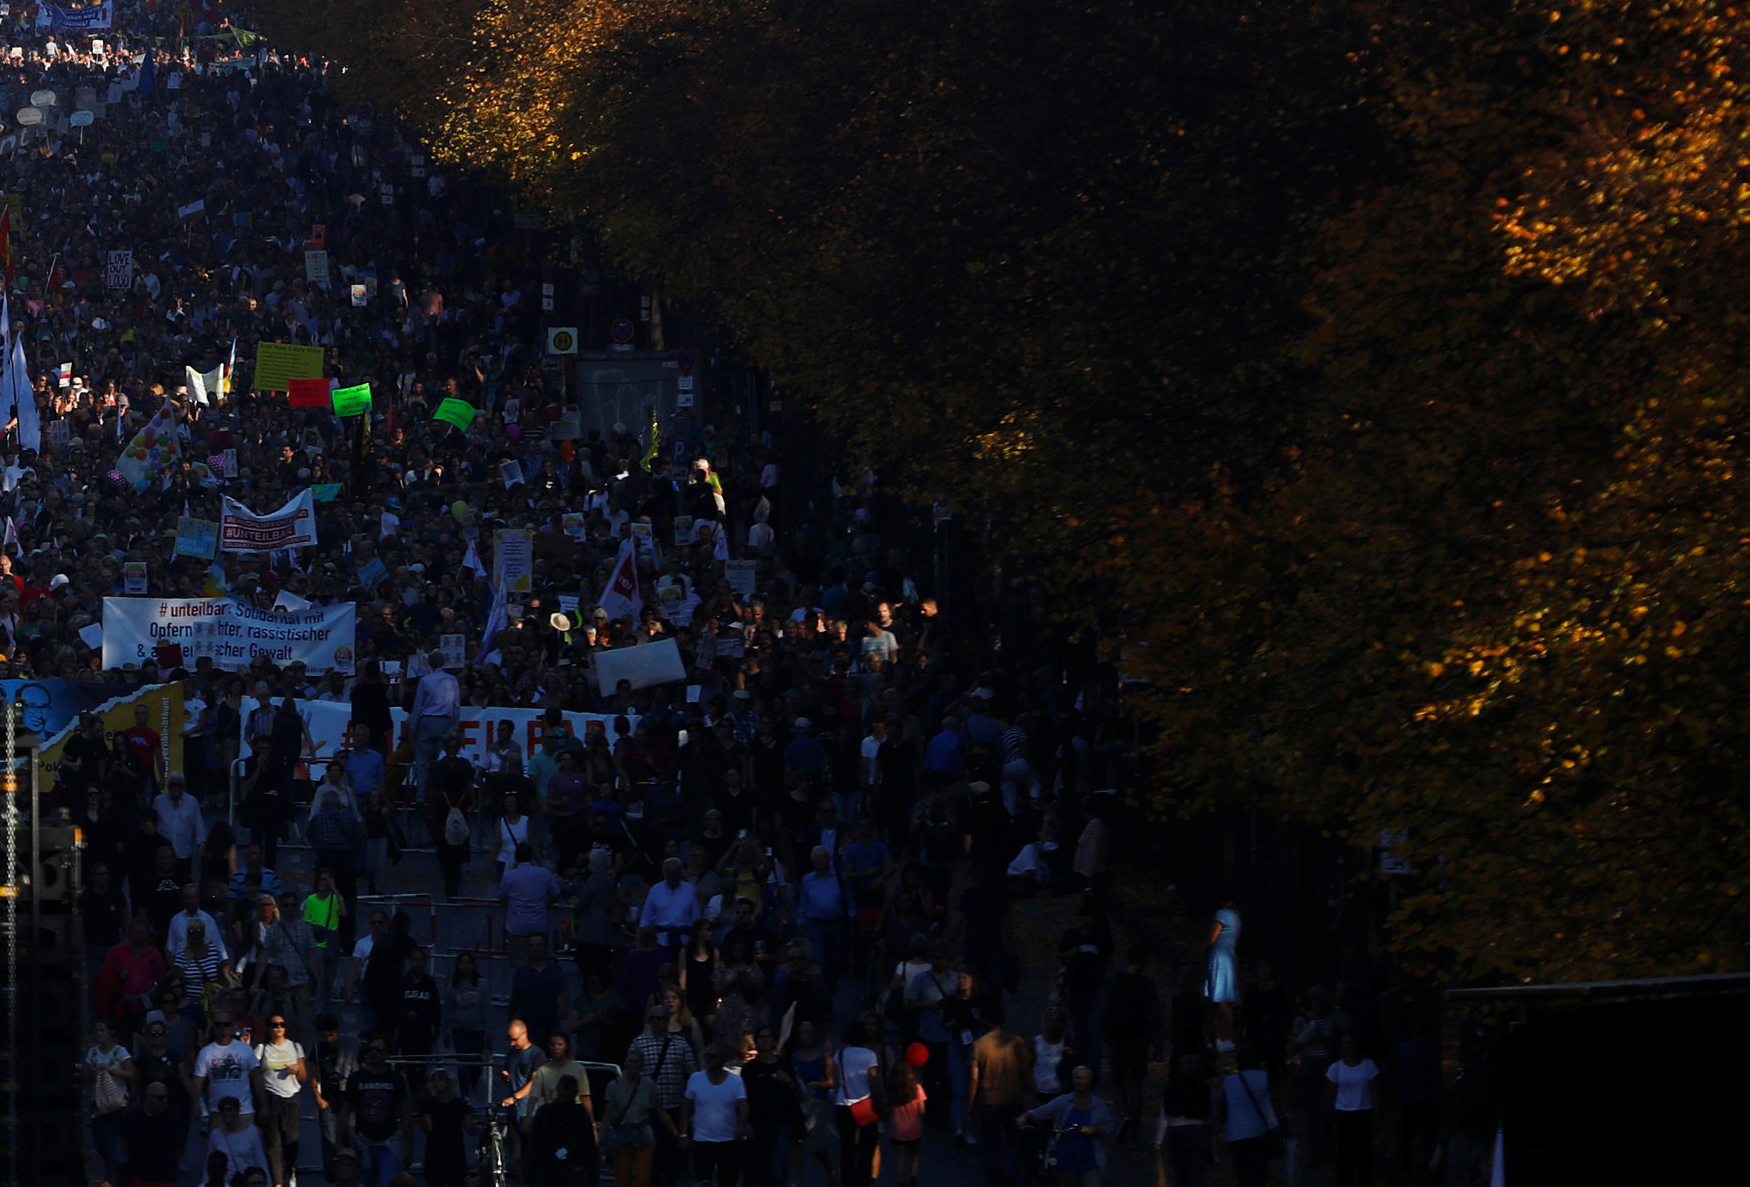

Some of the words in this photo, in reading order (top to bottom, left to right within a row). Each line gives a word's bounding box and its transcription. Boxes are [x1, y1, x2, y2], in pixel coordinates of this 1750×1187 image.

[109, 253, 130, 265] LOVE
[109, 265, 126, 273] OUT
[108, 273, 130, 288] LOUD
[225, 525, 293, 542] #UNTEILBAR
[304, 611, 324, 625] mit
[150, 622, 193, 639] Opfern
[248, 625, 331, 642] rassistischer
[137, 643, 146, 658] &
[250, 643, 292, 660] Gewalt
